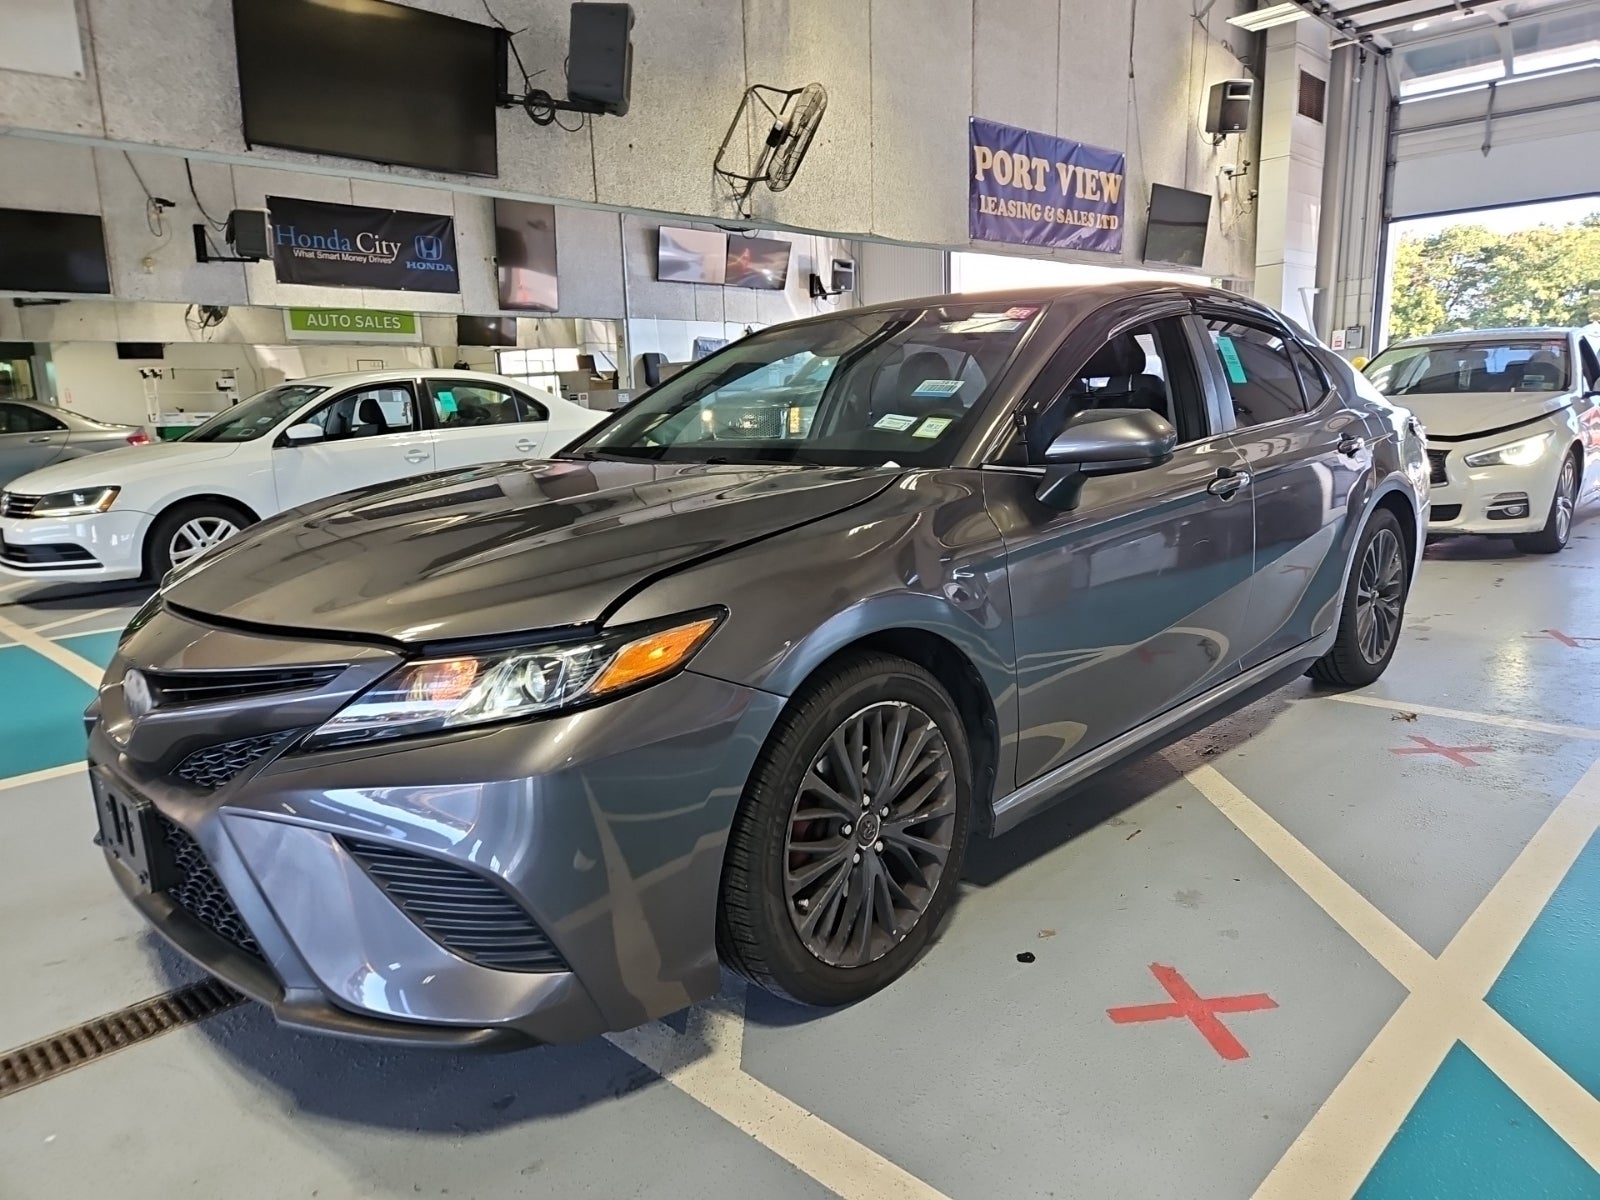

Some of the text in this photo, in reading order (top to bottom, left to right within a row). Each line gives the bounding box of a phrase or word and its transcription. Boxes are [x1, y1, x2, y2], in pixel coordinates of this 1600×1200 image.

[974, 145, 1122, 204] PORT VIEW
[979, 195, 1118, 230] LEASING & SALES LTD
[275, 224, 401, 262] Honda City
[293, 249, 392, 264] What Smart Money Drives
[406, 261, 454, 272] HONDA
[307, 313, 401, 330] AUTO SALES
